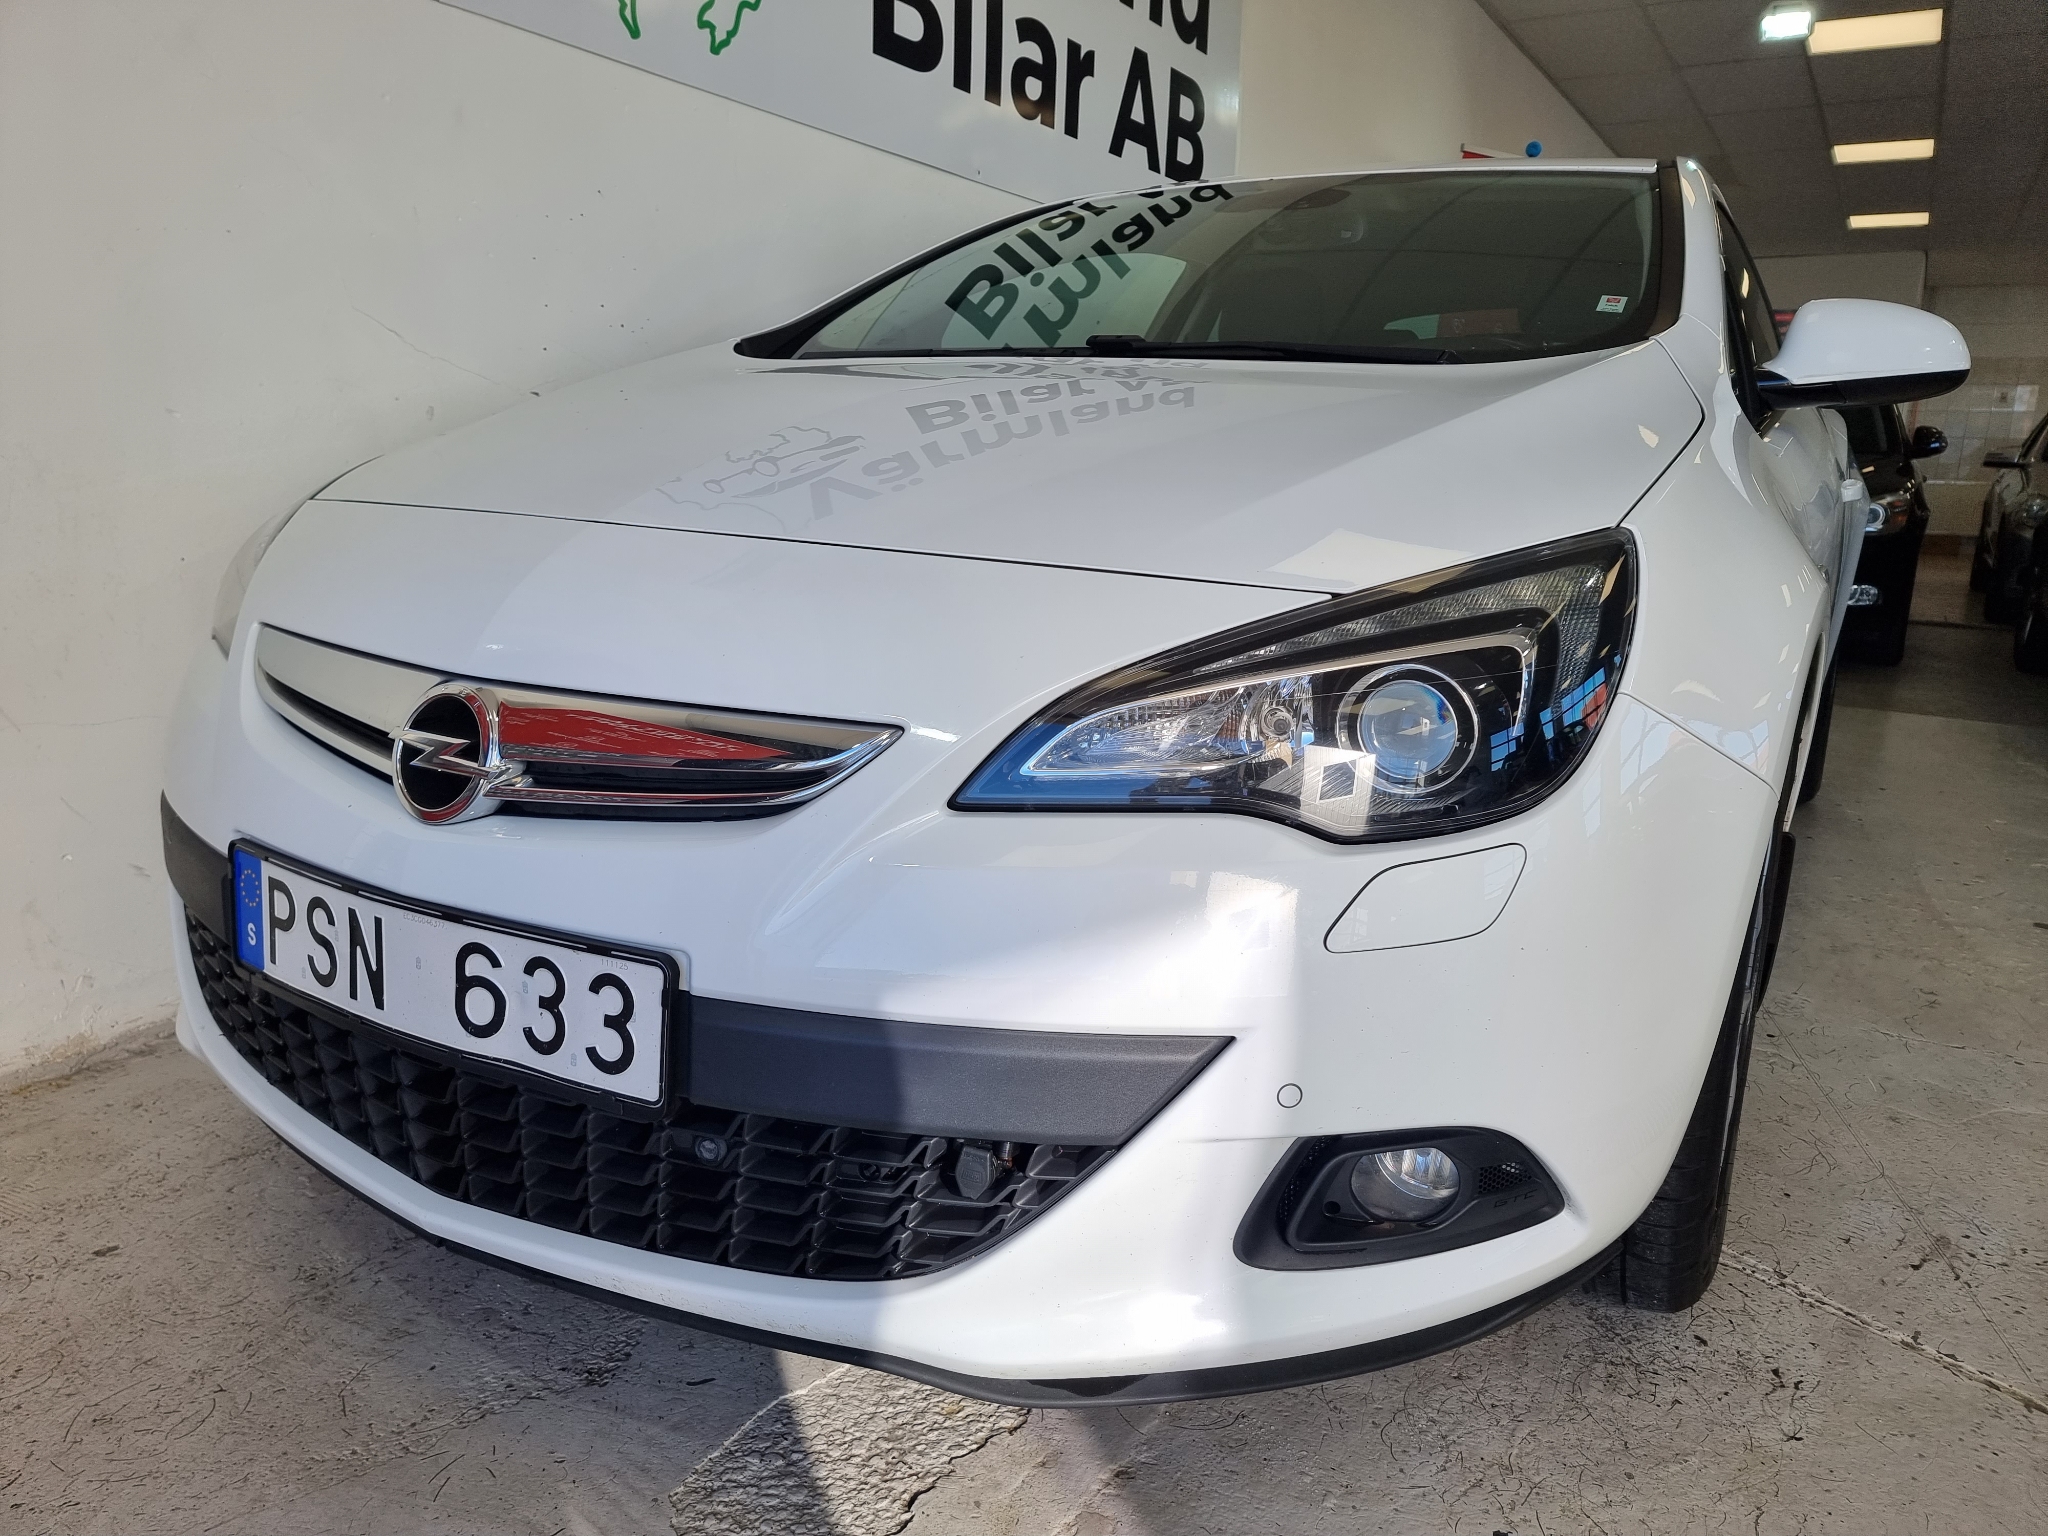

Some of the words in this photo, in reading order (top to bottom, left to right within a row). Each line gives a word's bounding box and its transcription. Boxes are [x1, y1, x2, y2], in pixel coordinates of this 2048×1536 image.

[1108, 46, 1205, 183] AB
[247, 922, 257, 946] S
[267, 875, 385, 1011] PSN
[454, 941, 636, 1076] 633
